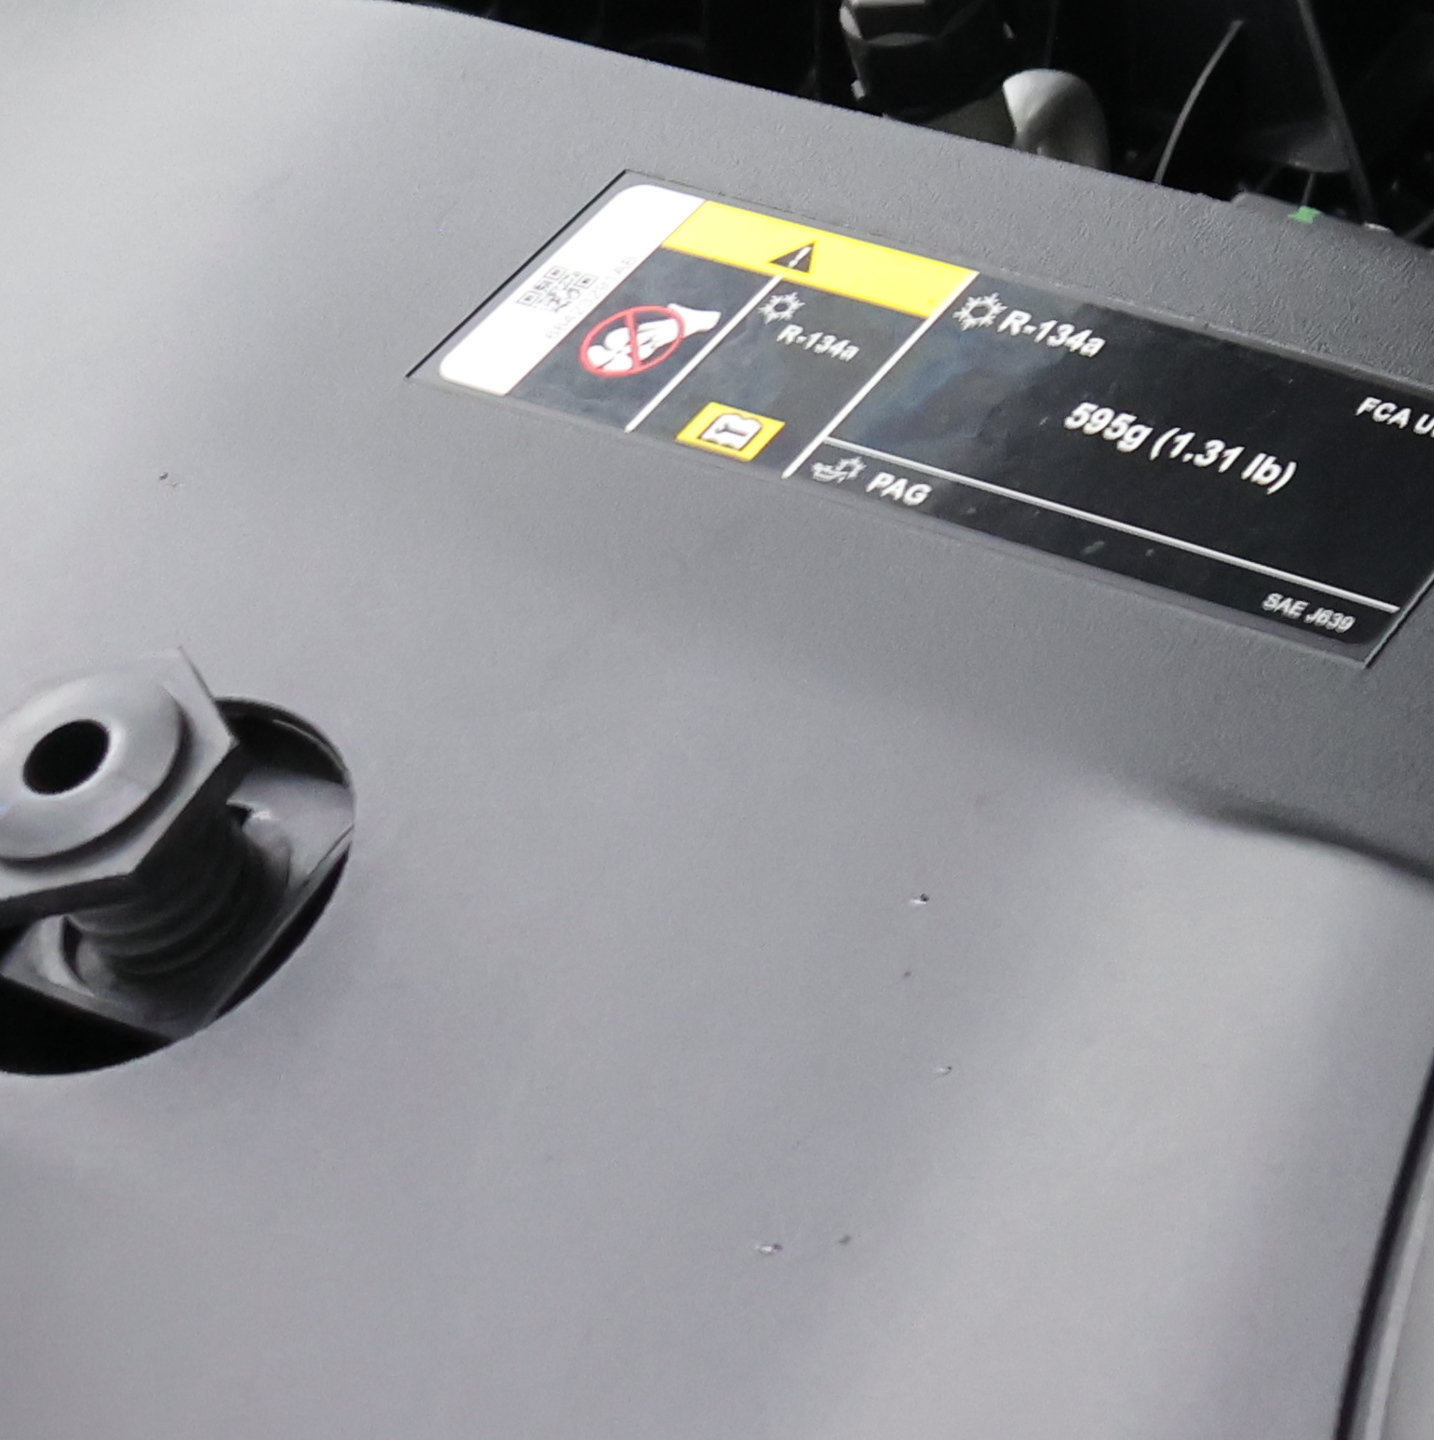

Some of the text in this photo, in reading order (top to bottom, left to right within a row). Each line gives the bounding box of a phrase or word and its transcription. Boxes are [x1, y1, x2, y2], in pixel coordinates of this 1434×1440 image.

[776, 324, 859, 362] R-134a
[997, 309, 1105, 358] R-134a
[1356, 397, 1410, 428] FCA
[1063, 402, 1297, 494] 595g (1.31 lb)
[866, 472, 933, 507] PAG
[1261, 592, 1356, 634] SAE J639
